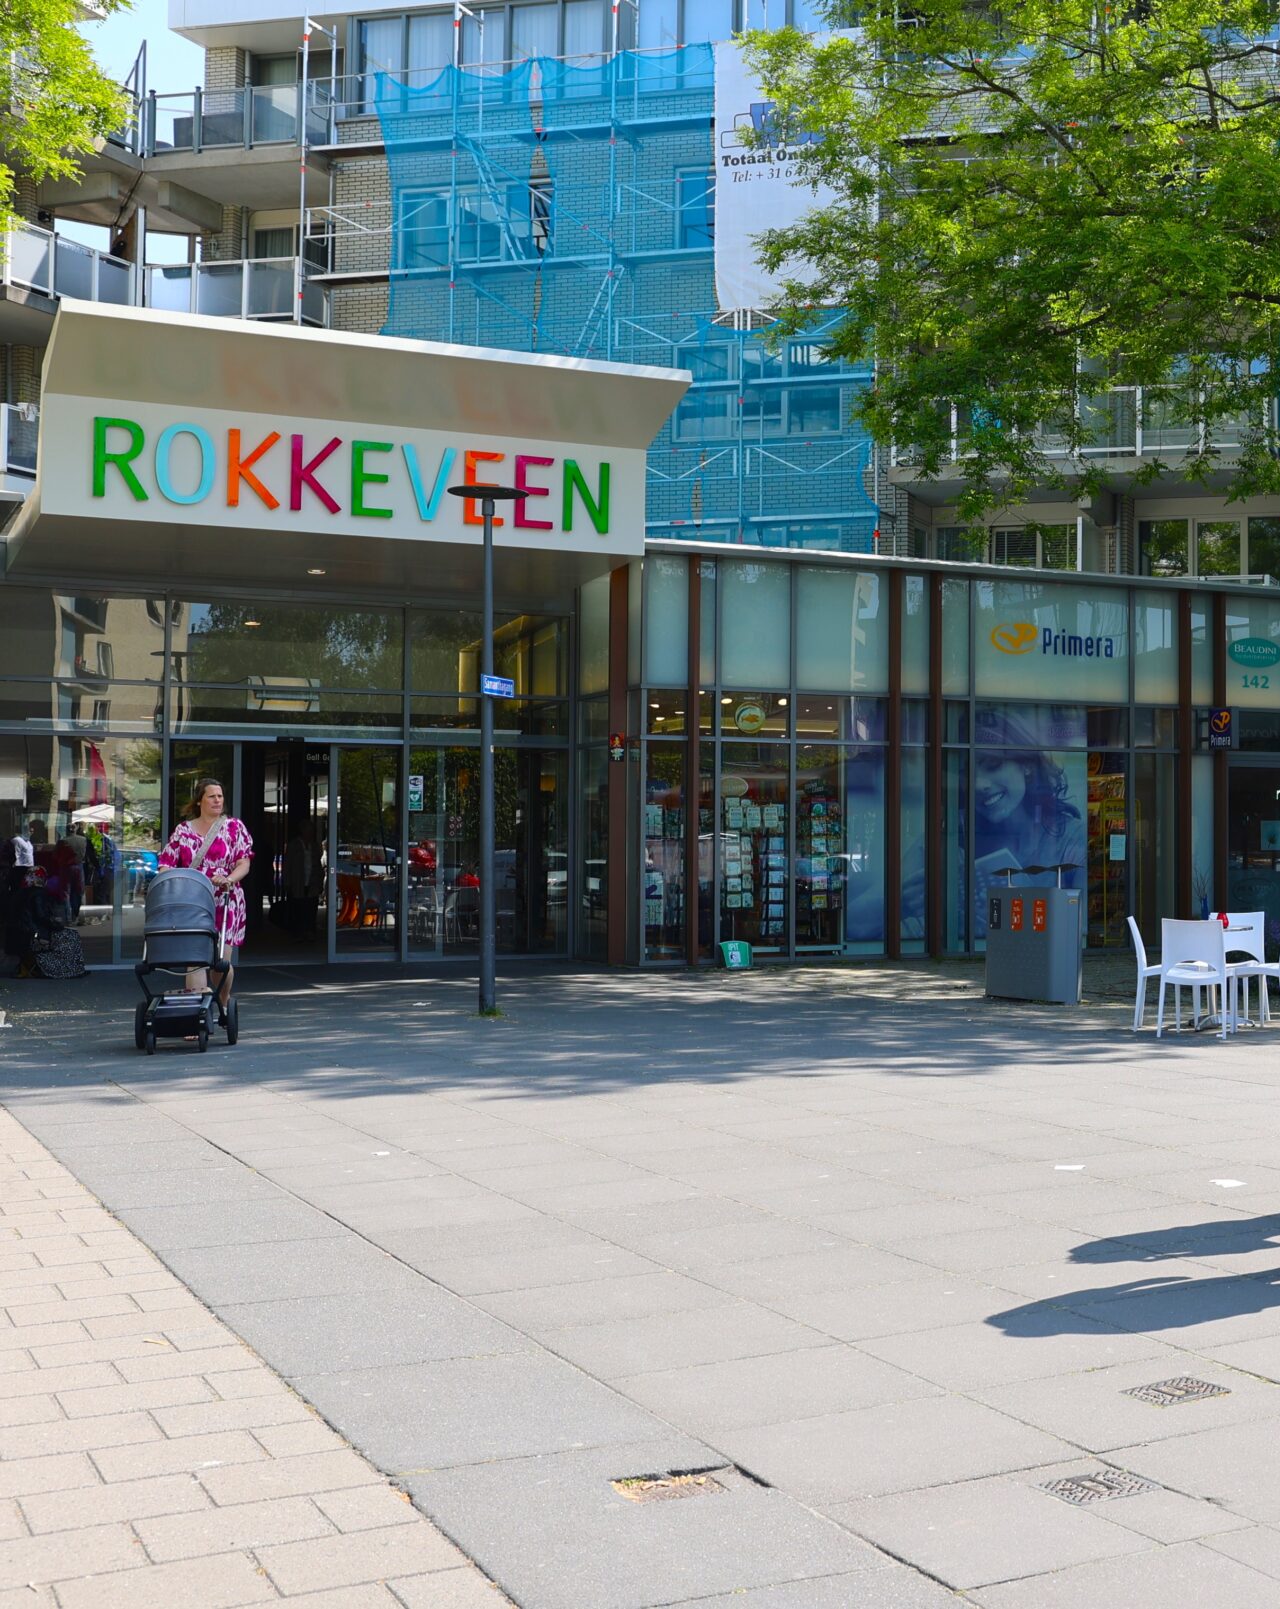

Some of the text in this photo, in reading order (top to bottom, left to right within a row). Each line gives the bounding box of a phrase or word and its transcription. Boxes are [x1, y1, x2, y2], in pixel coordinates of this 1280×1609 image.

[722, 151, 772, 167] Totaal
[732, 170, 752, 183] Tel:
[768, 168, 780, 179] 31
[92, 416, 610, 535] ROKKEVEEN
[1043, 628, 1113, 658] Primera
[1242, 674, 1269, 689] 142
[1210, 734, 1231, 747] Primera
